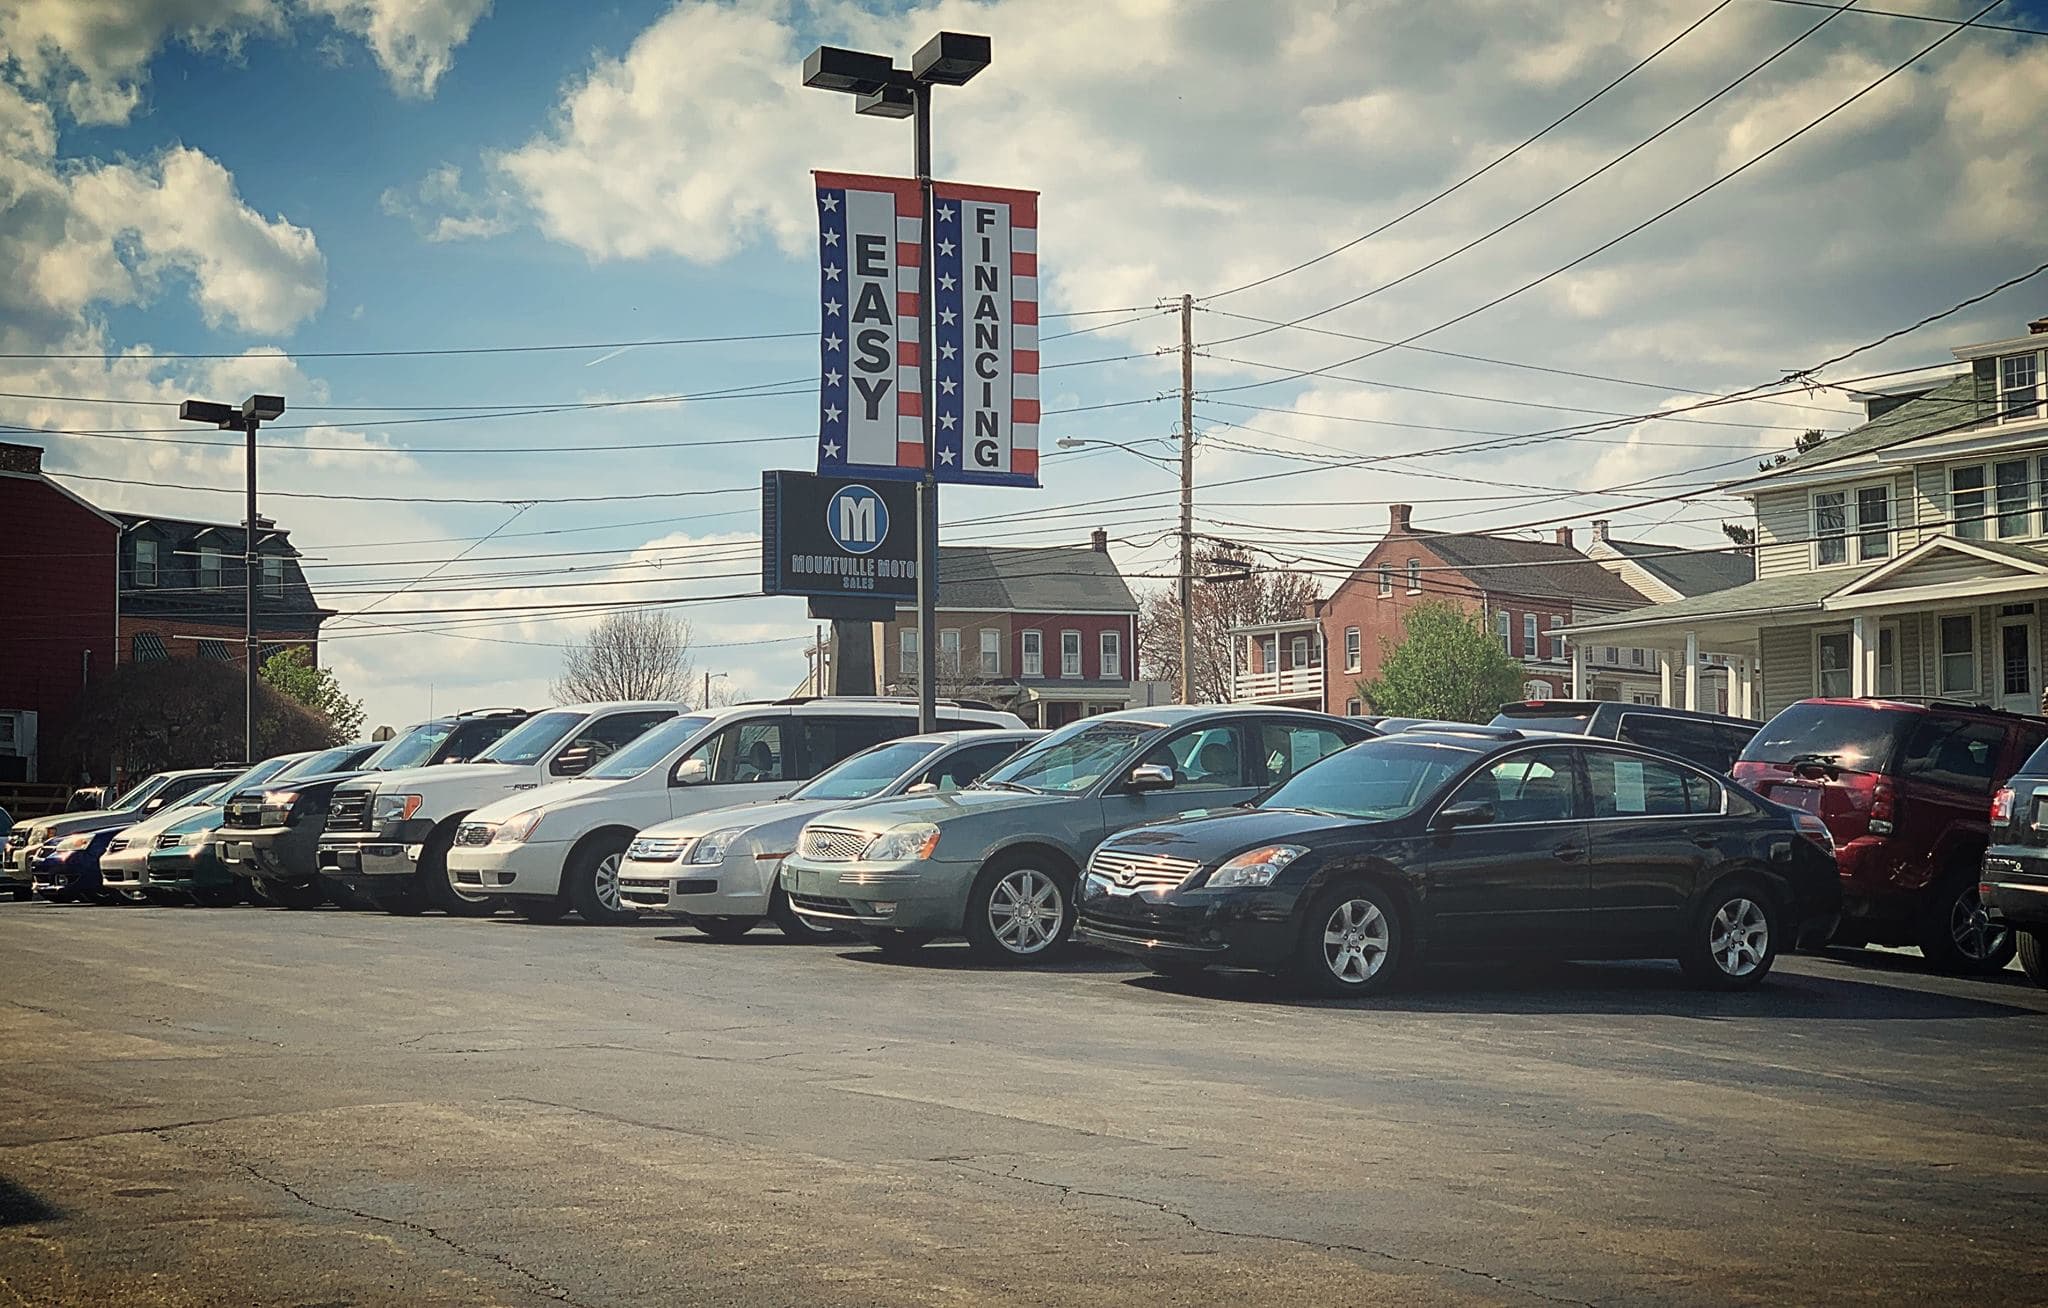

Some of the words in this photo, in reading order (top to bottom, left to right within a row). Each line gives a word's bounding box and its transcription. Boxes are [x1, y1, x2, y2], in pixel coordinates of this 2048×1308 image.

[851, 234, 893, 421] EASY
[973, 208, 1000, 468] FINANCING
[839, 496, 876, 543] M
[792, 554, 875, 577] MOUNTVILLE
[878, 559, 919, 579] MOTO
[843, 576, 874, 590] SALES
